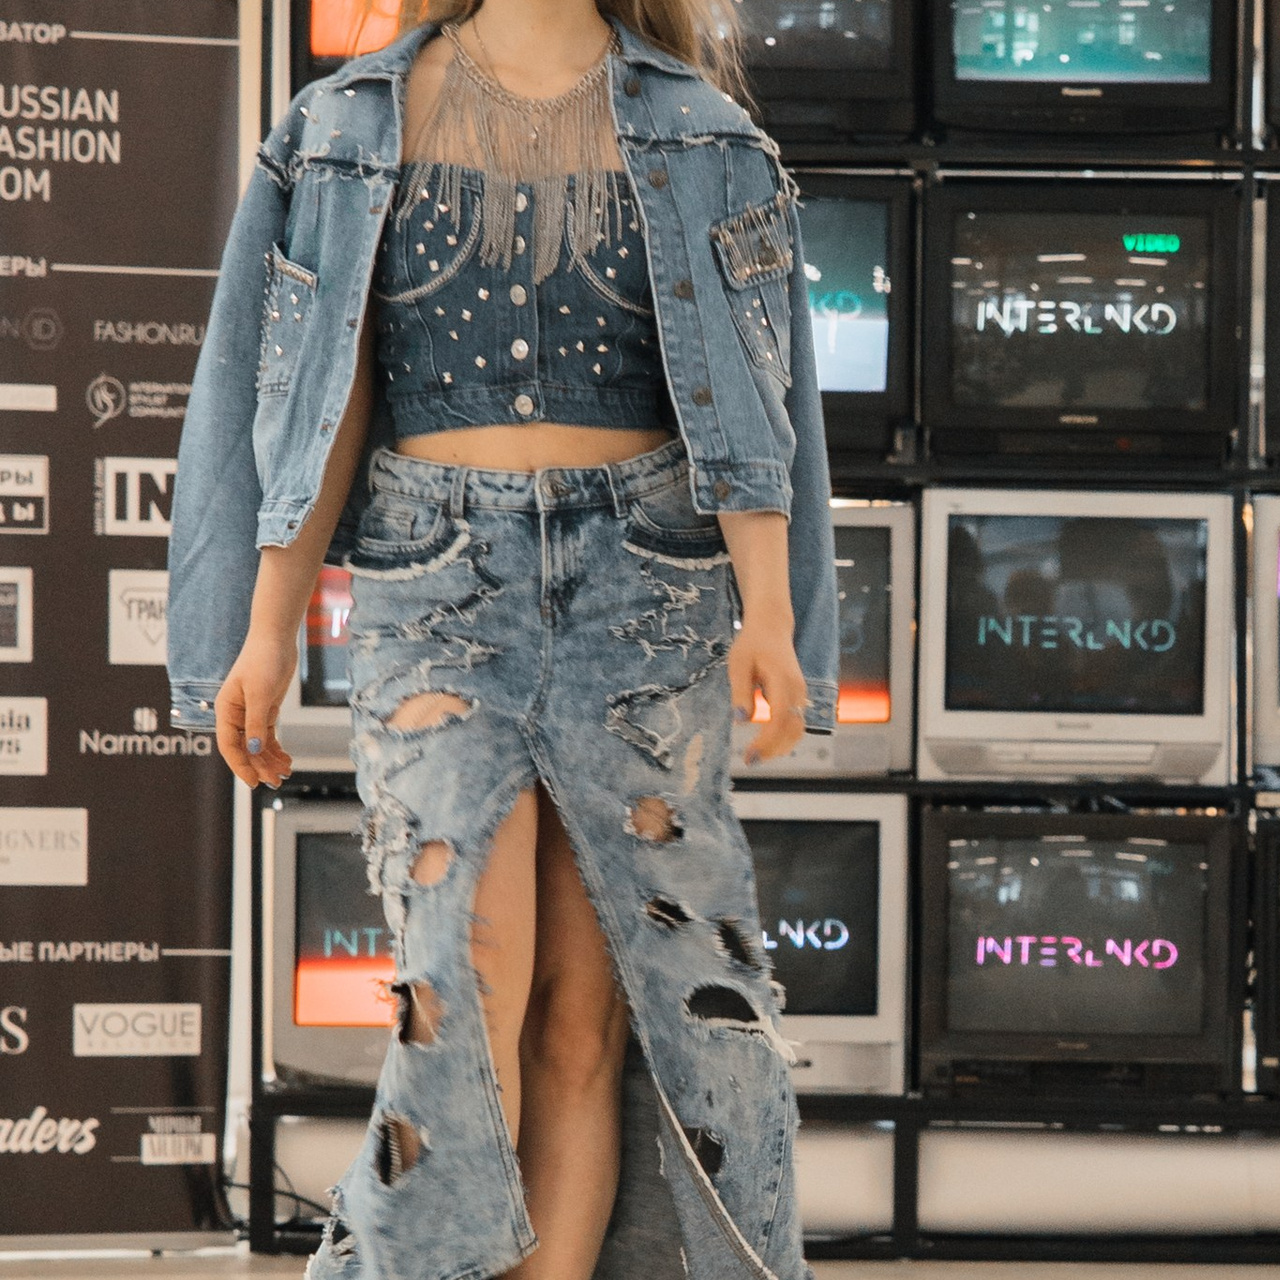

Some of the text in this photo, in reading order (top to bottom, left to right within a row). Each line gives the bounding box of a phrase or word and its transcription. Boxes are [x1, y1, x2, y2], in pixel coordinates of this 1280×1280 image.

[1121, 233, 1181, 254] VIDEO
[38, 941, 160, 963] ПАРТНЕРЫ
[79, 1010, 196, 1039] VOGUE
